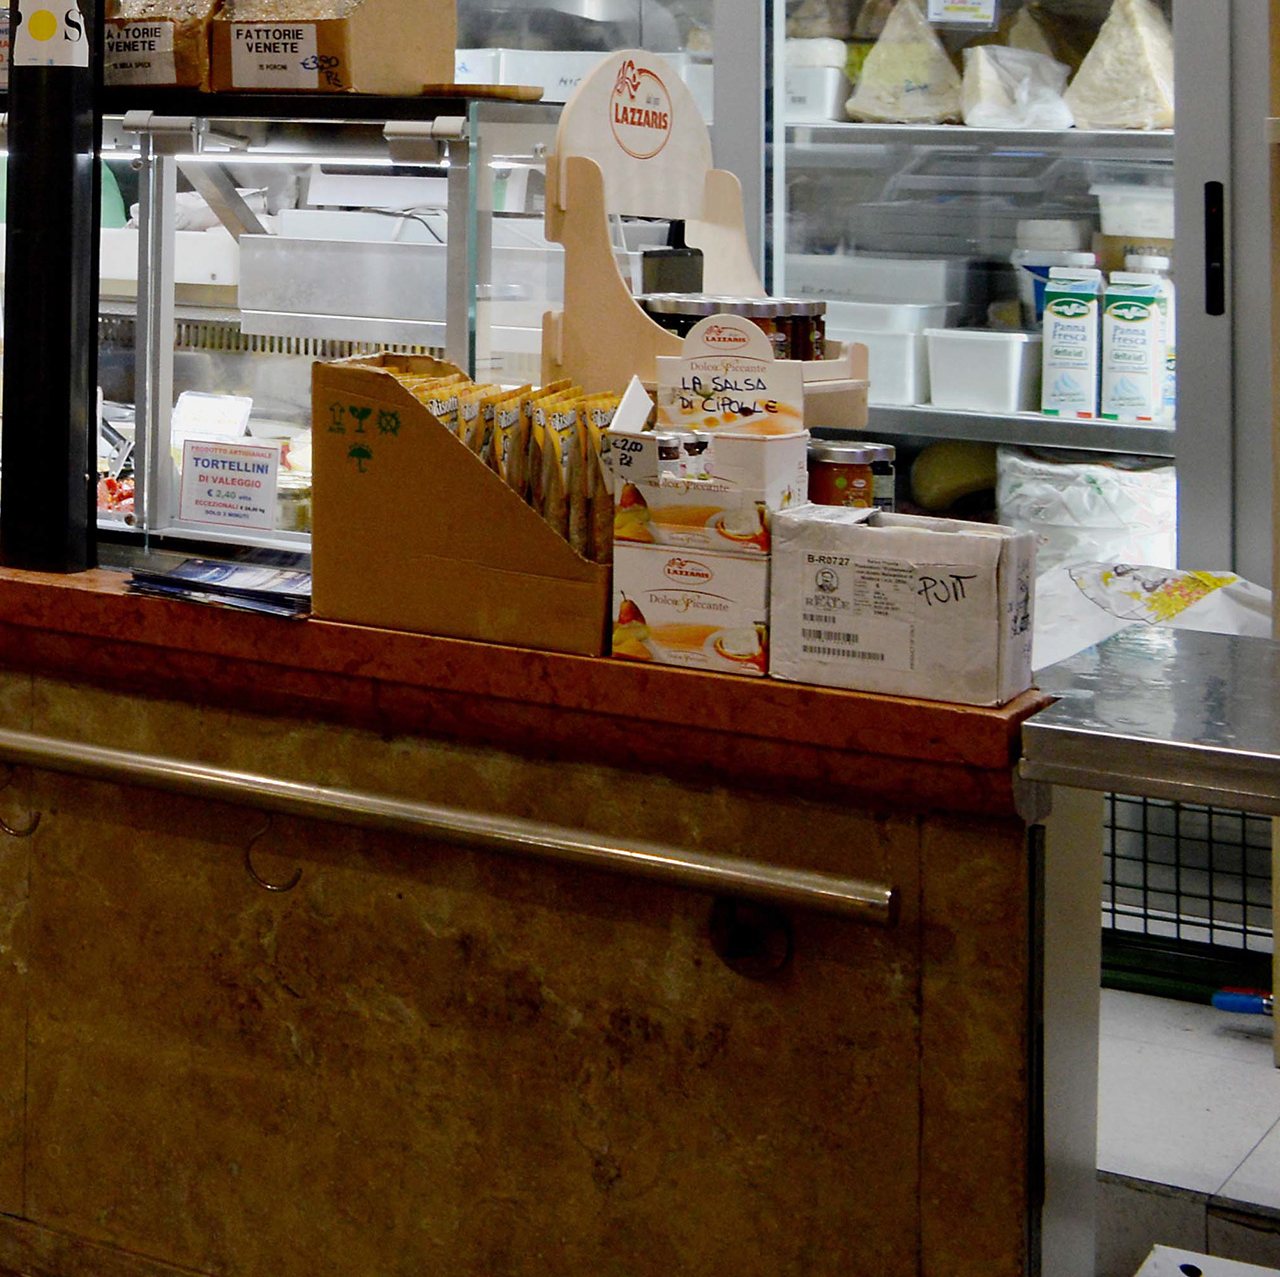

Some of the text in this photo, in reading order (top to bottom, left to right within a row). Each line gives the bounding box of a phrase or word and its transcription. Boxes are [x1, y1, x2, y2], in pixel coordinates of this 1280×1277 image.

[236, 28, 304, 41] FATTORIE
[107, 41, 156, 52] VENETE
[246, 42, 299, 53] VENETE
[615, 103, 668, 130] LAZZARIS
[1053, 322, 1086, 332] Panna
[1113, 325, 1146, 336] Panna
[1052, 332, 1087, 342] Fresca
[1112, 335, 1147, 346] Fresca
[681, 376, 767, 392] LA SALSA
[191, 446, 273, 459] PRODOTTO ARTIGIANALE
[193, 457, 269, 474] TORTELLINI
[211, 476, 261, 488] VALEGGIO
[207, 489, 213, 497] €
[216, 489, 236, 499] 2,40
[195, 499, 238, 510] ECCEZIONALI
[807, 554, 851, 567] B-R0727
